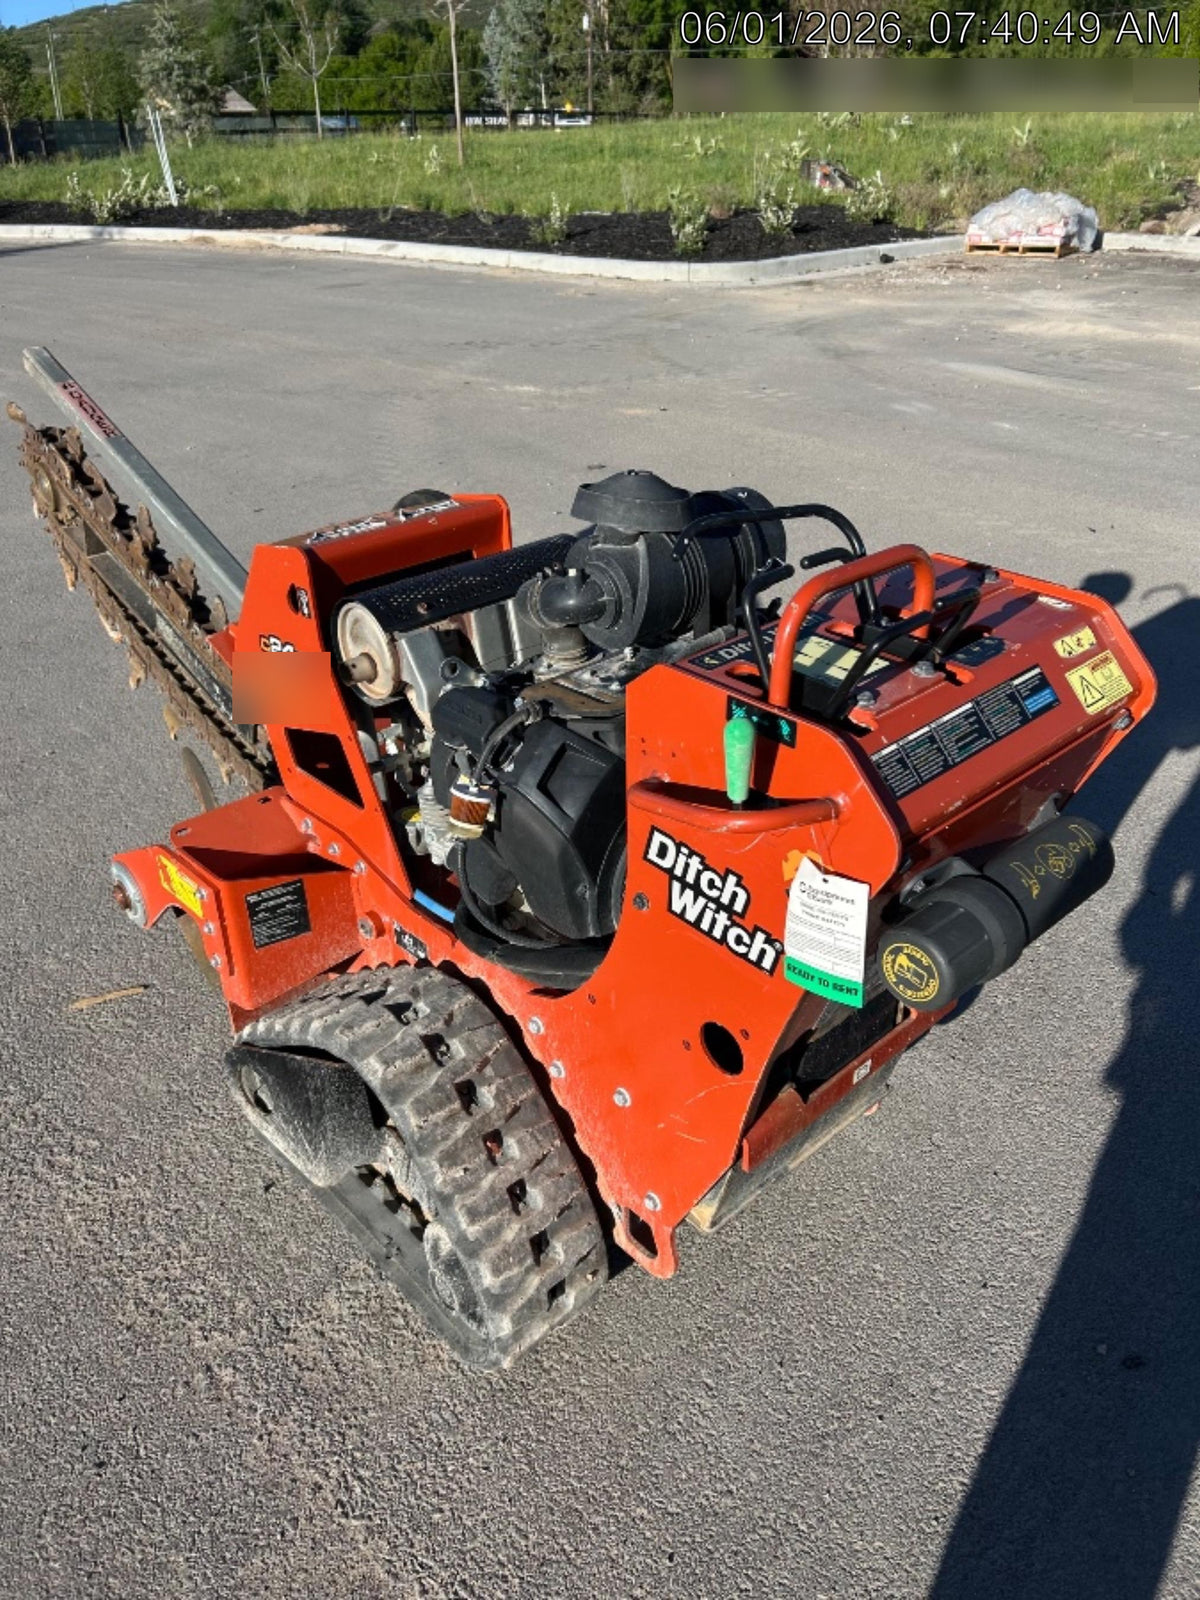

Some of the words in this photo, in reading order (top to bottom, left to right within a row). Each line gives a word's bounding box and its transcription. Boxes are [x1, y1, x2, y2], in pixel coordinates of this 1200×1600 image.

[645, 829, 749, 912] Ditch
[670, 879, 782, 972] Witch
[818, 977, 830, 988] TO
